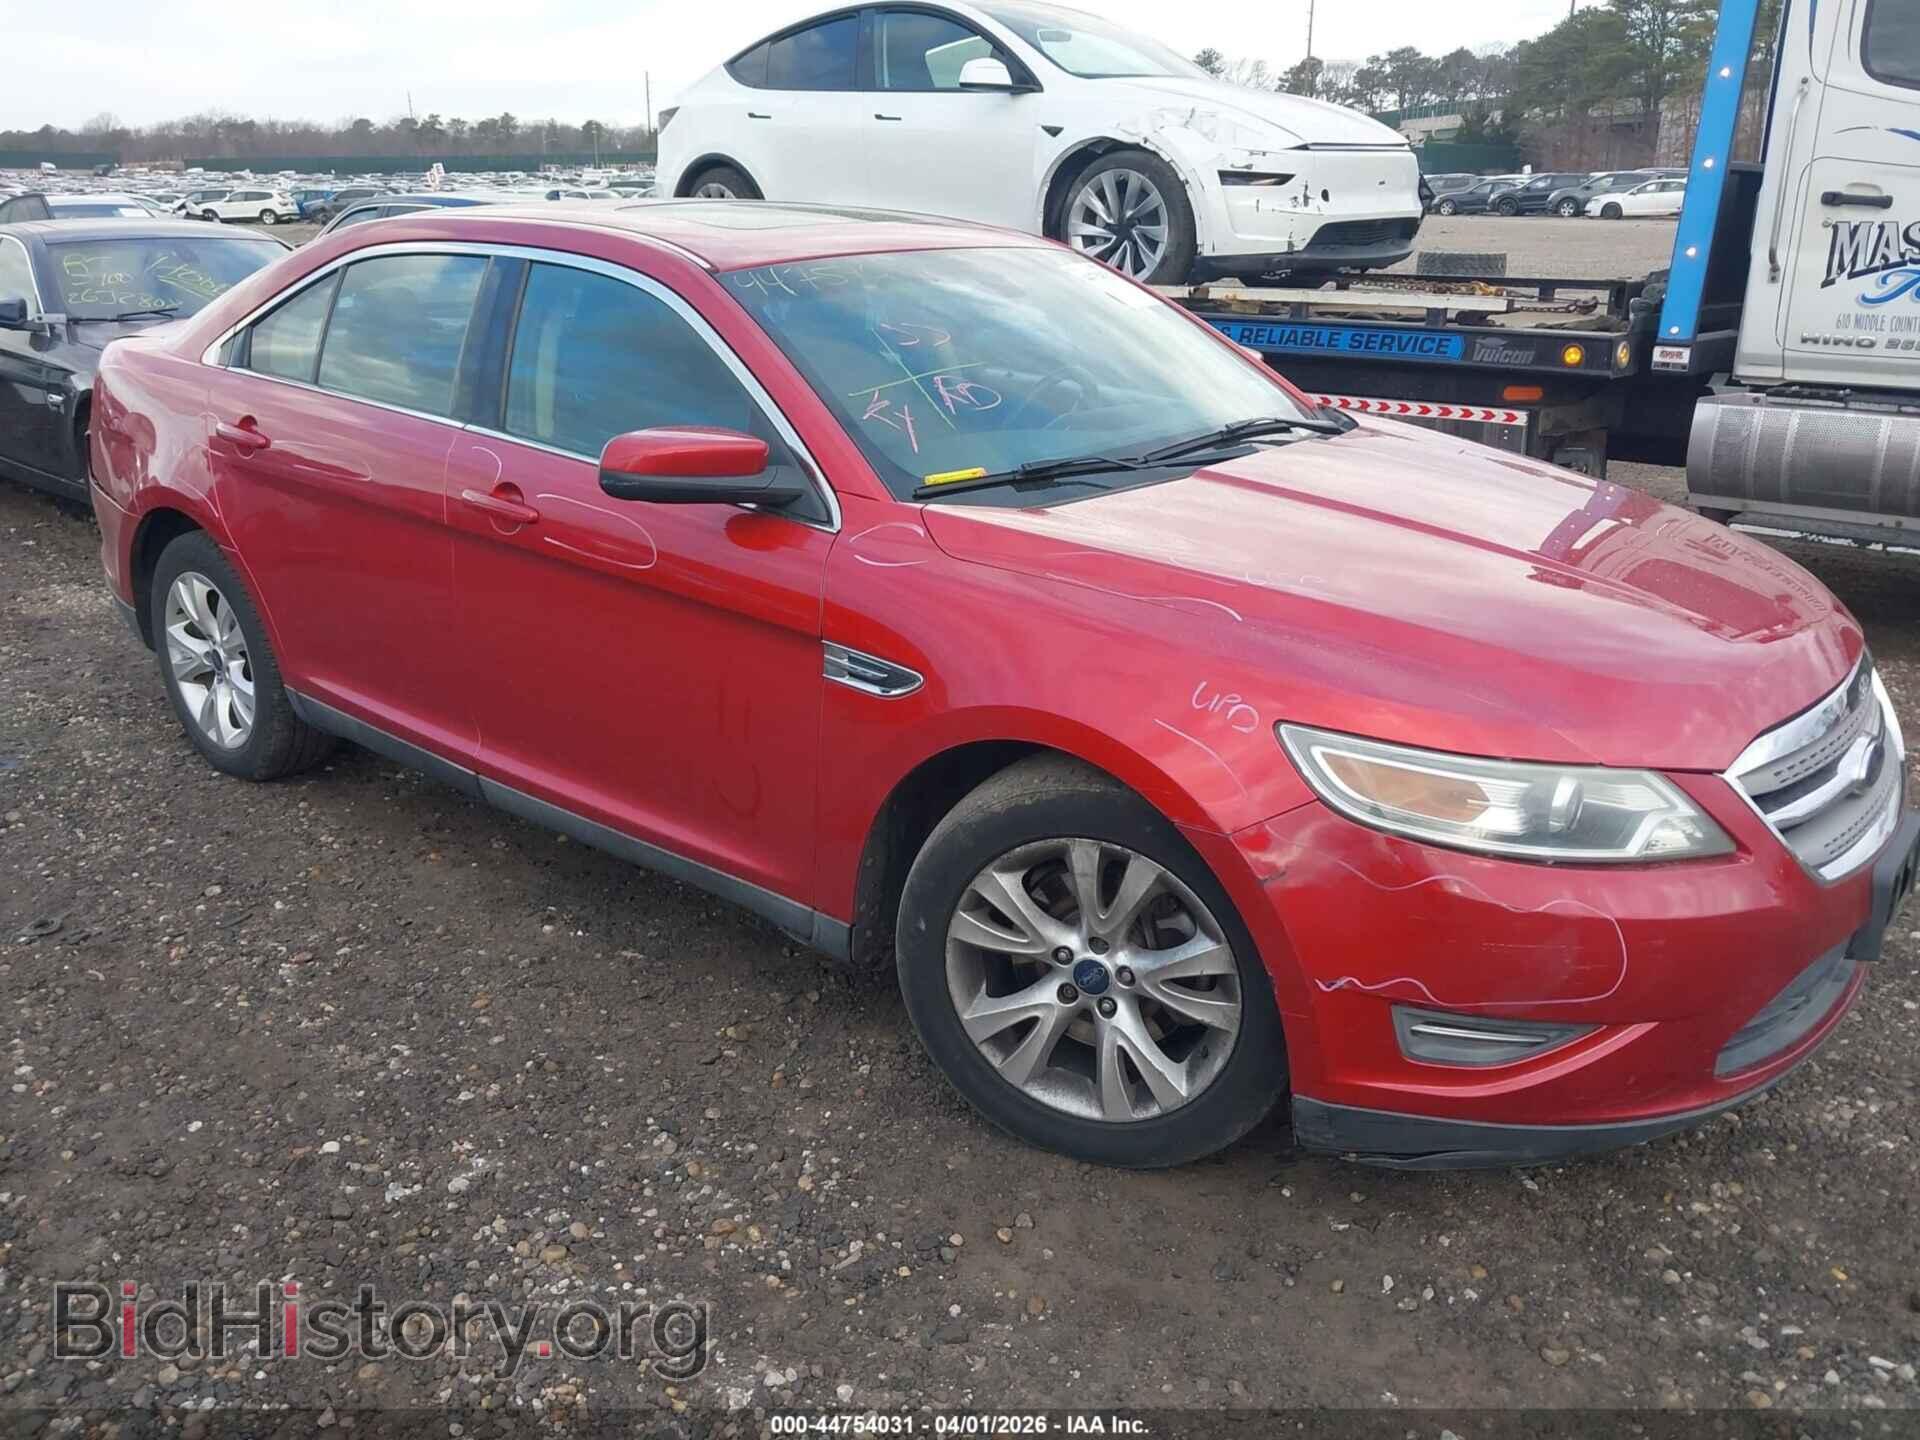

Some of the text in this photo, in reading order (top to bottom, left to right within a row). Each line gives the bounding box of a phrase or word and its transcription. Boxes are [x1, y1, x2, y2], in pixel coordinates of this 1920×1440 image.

[1854, 313, 1886, 332] MIDDLE
[1889, 315, 1920, 334] COUNT
[1239, 326, 1341, 349] RELIABLE
[1348, 331, 1452, 355] SERVICE
[1800, 332, 1877, 348] HINO
